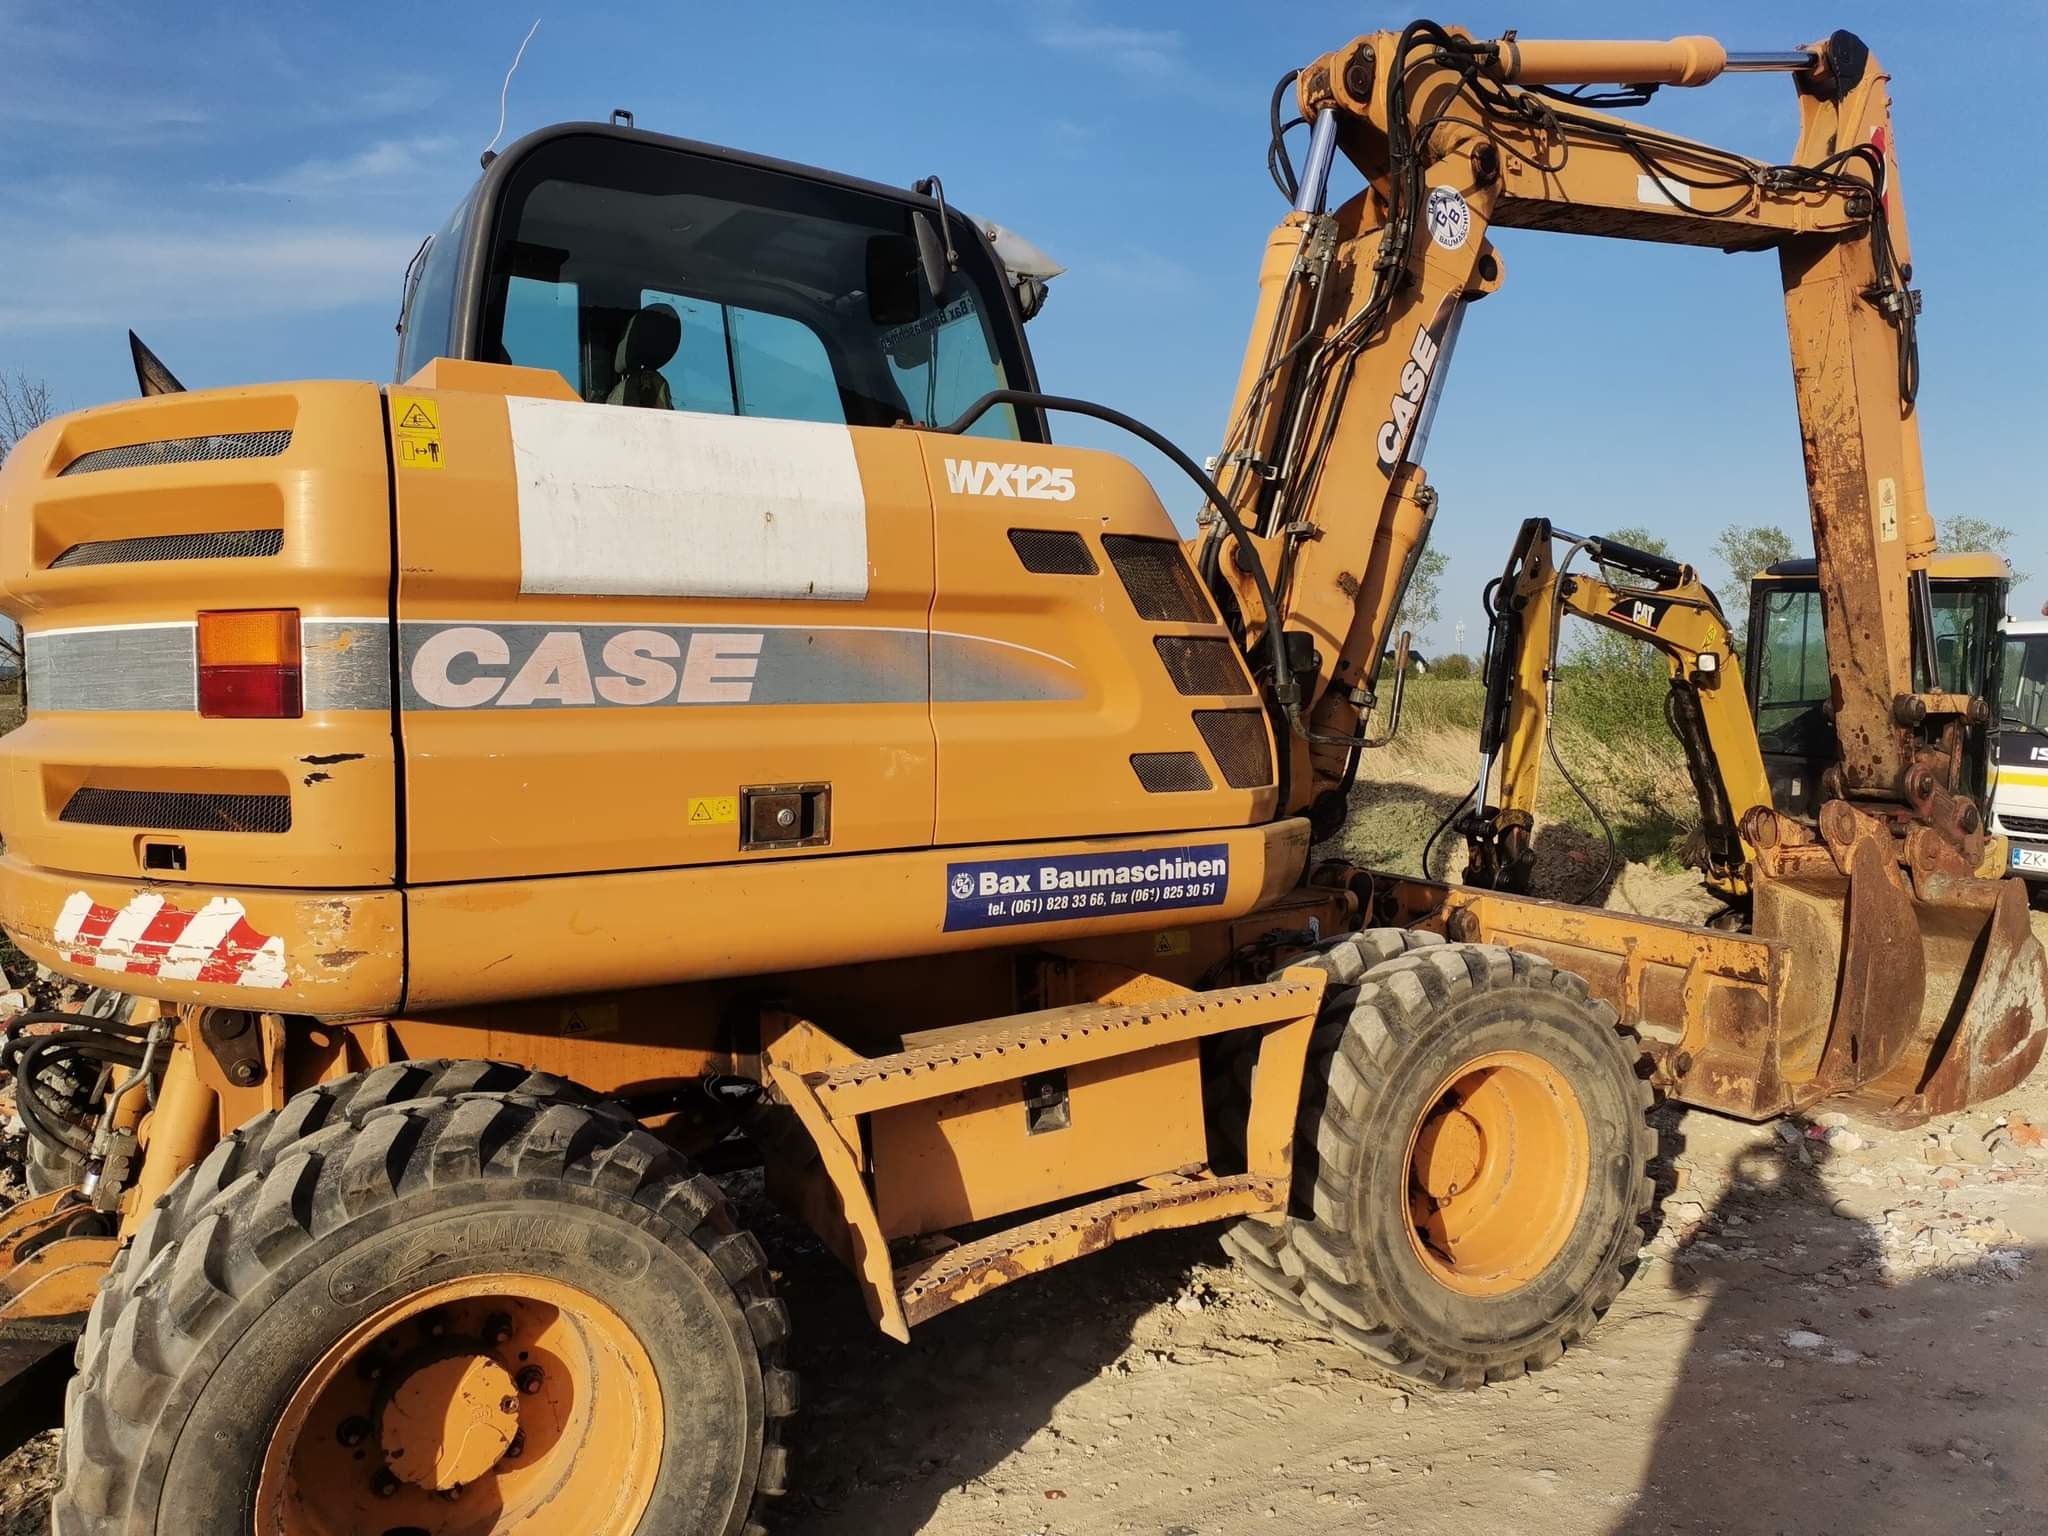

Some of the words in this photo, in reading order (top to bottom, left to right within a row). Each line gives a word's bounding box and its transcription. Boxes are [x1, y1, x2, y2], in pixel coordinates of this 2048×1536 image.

[1377, 326, 1439, 464] CASE
[944, 458, 1076, 501] WX125
[1632, 600, 1656, 628] CAT
[411, 627, 765, 708] CASE
[979, 871, 1032, 896] Bax
[1039, 857, 1227, 891] Baumaschinen
[987, 901, 1007, 917] tel.
[1011, 897, 1042, 917] (061)
[1046, 894, 1069, 911] 828
[1072, 893, 1088, 909] 33
[1090, 892, 1107, 908] 66,
[1110, 889, 1128, 905] fax
[1163, 884, 1184, 900] 825
[1186, 883, 1200, 898] 30
[1202, 882, 1216, 897] 51
